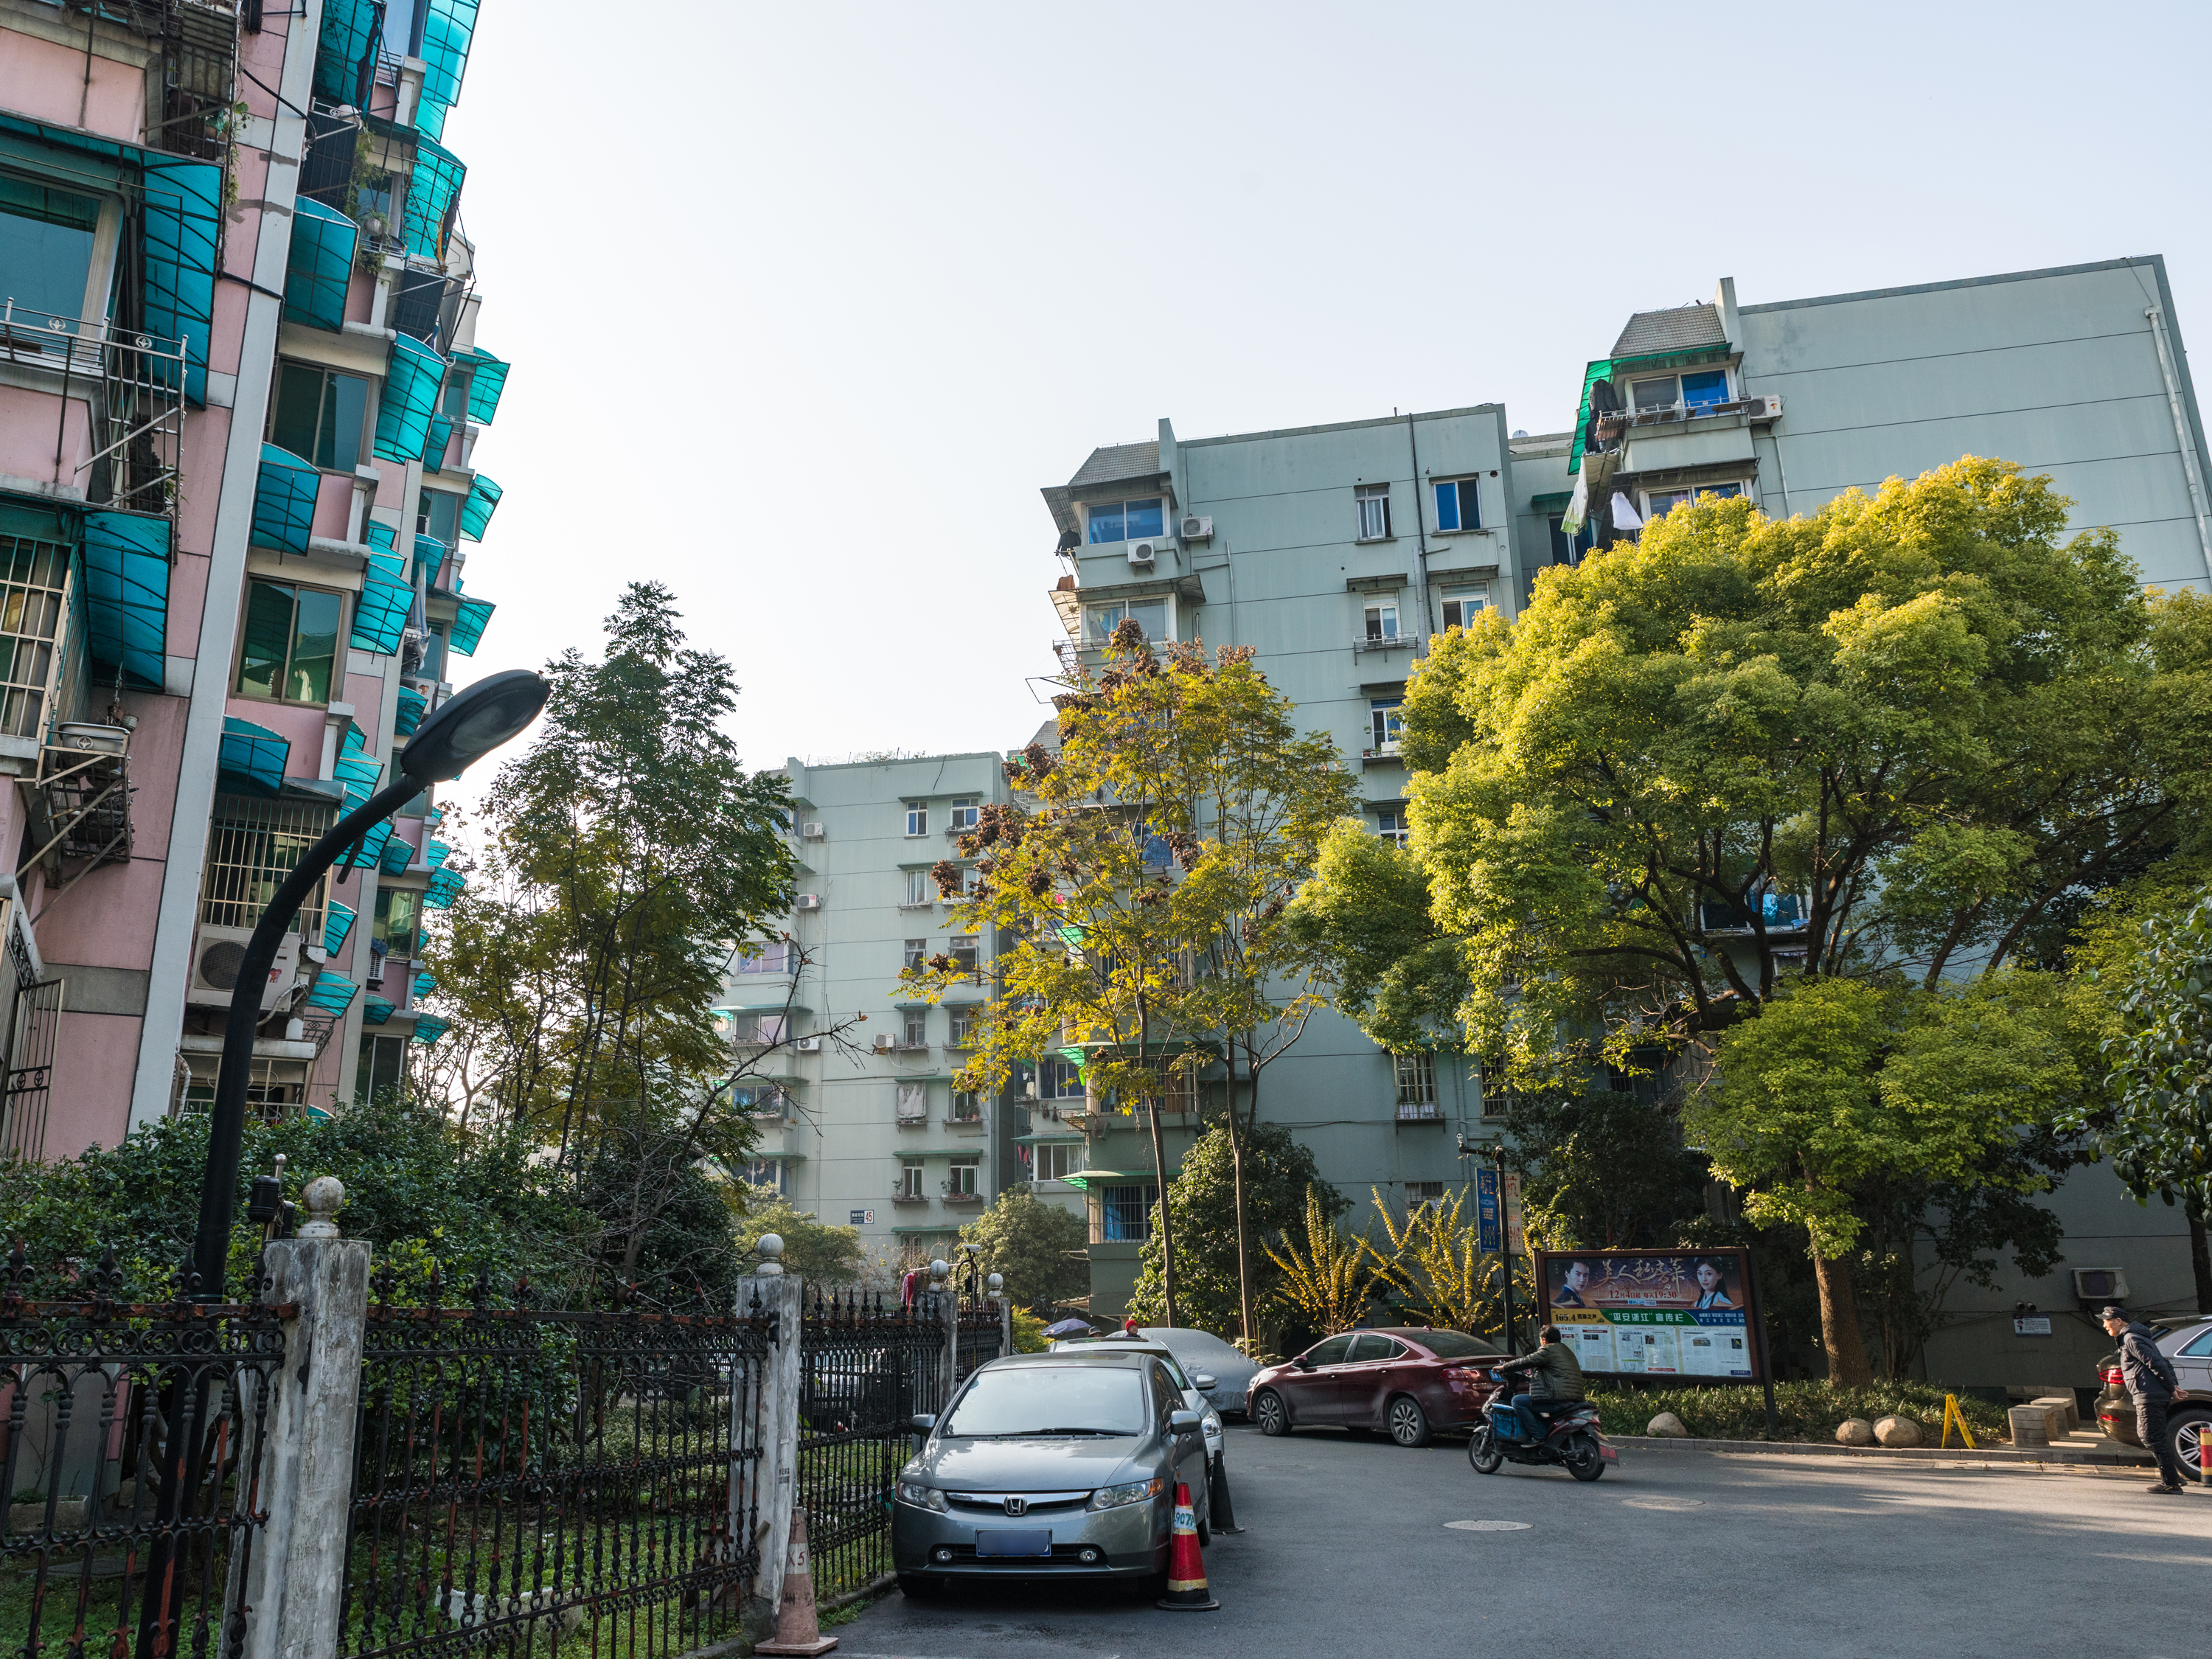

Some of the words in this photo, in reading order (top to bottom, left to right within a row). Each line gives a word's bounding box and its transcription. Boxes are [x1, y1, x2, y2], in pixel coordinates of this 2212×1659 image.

[865, 1211, 872, 1222] 45
[1610, 1290, 1641, 1298] 12月4日起
[1644, 1291, 1677, 1299] 每天19:30
